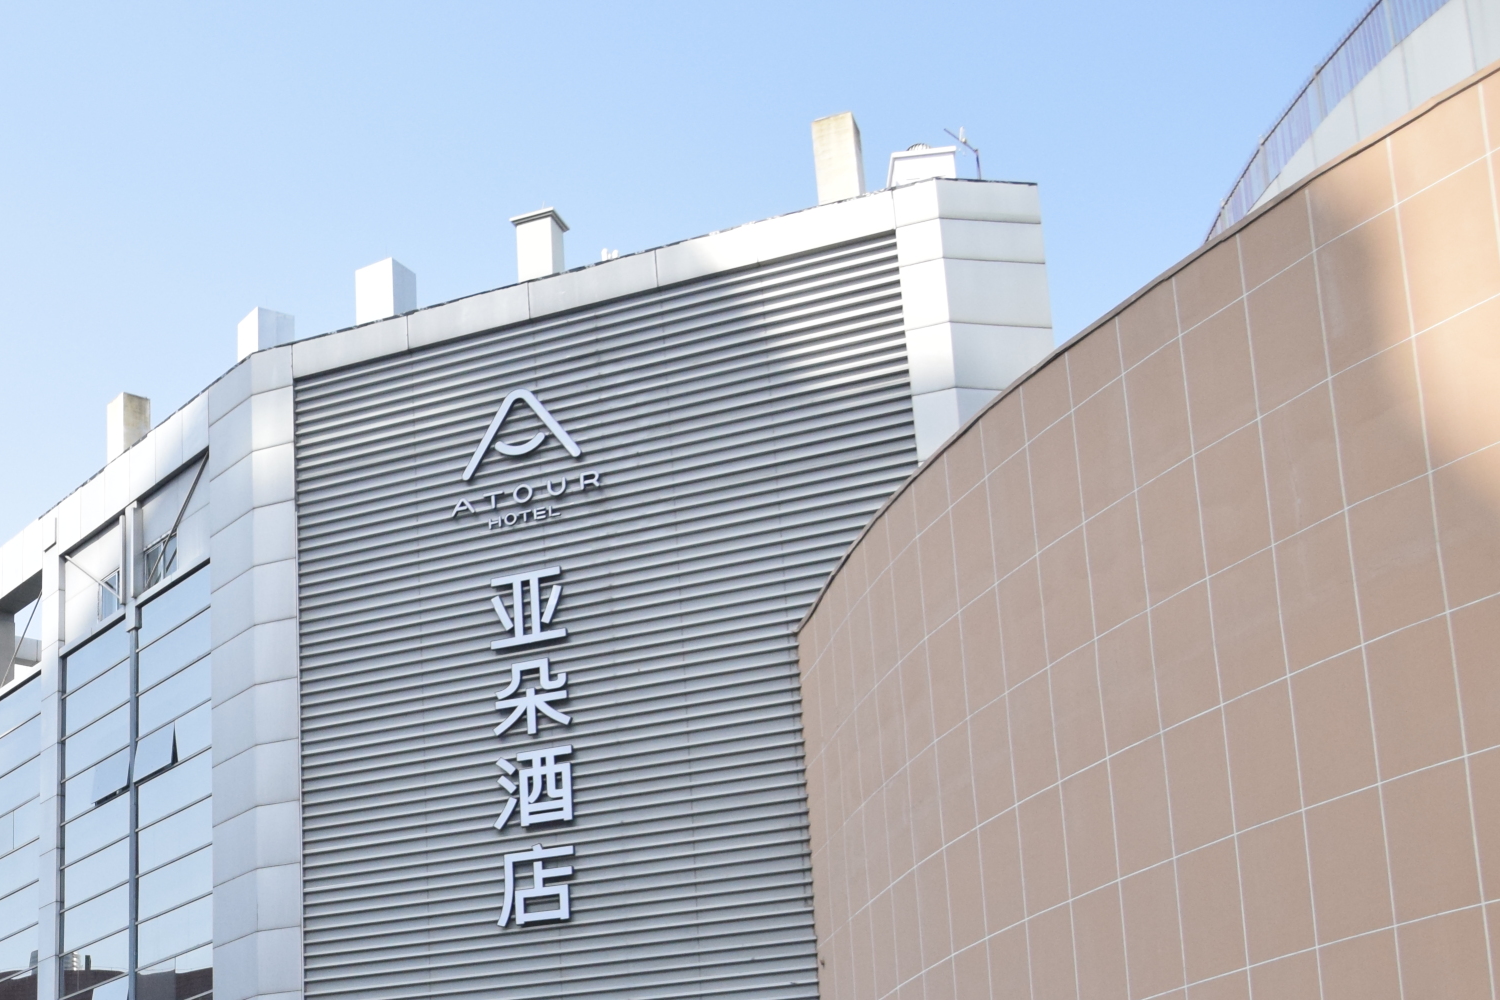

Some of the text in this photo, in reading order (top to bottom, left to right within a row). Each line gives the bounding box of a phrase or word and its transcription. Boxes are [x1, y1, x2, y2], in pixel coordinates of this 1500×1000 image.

[450, 470, 604, 520] ATOUR
[487, 505, 562, 530] HOTEL
[489, 565, 576, 929] 亚朵酒店
